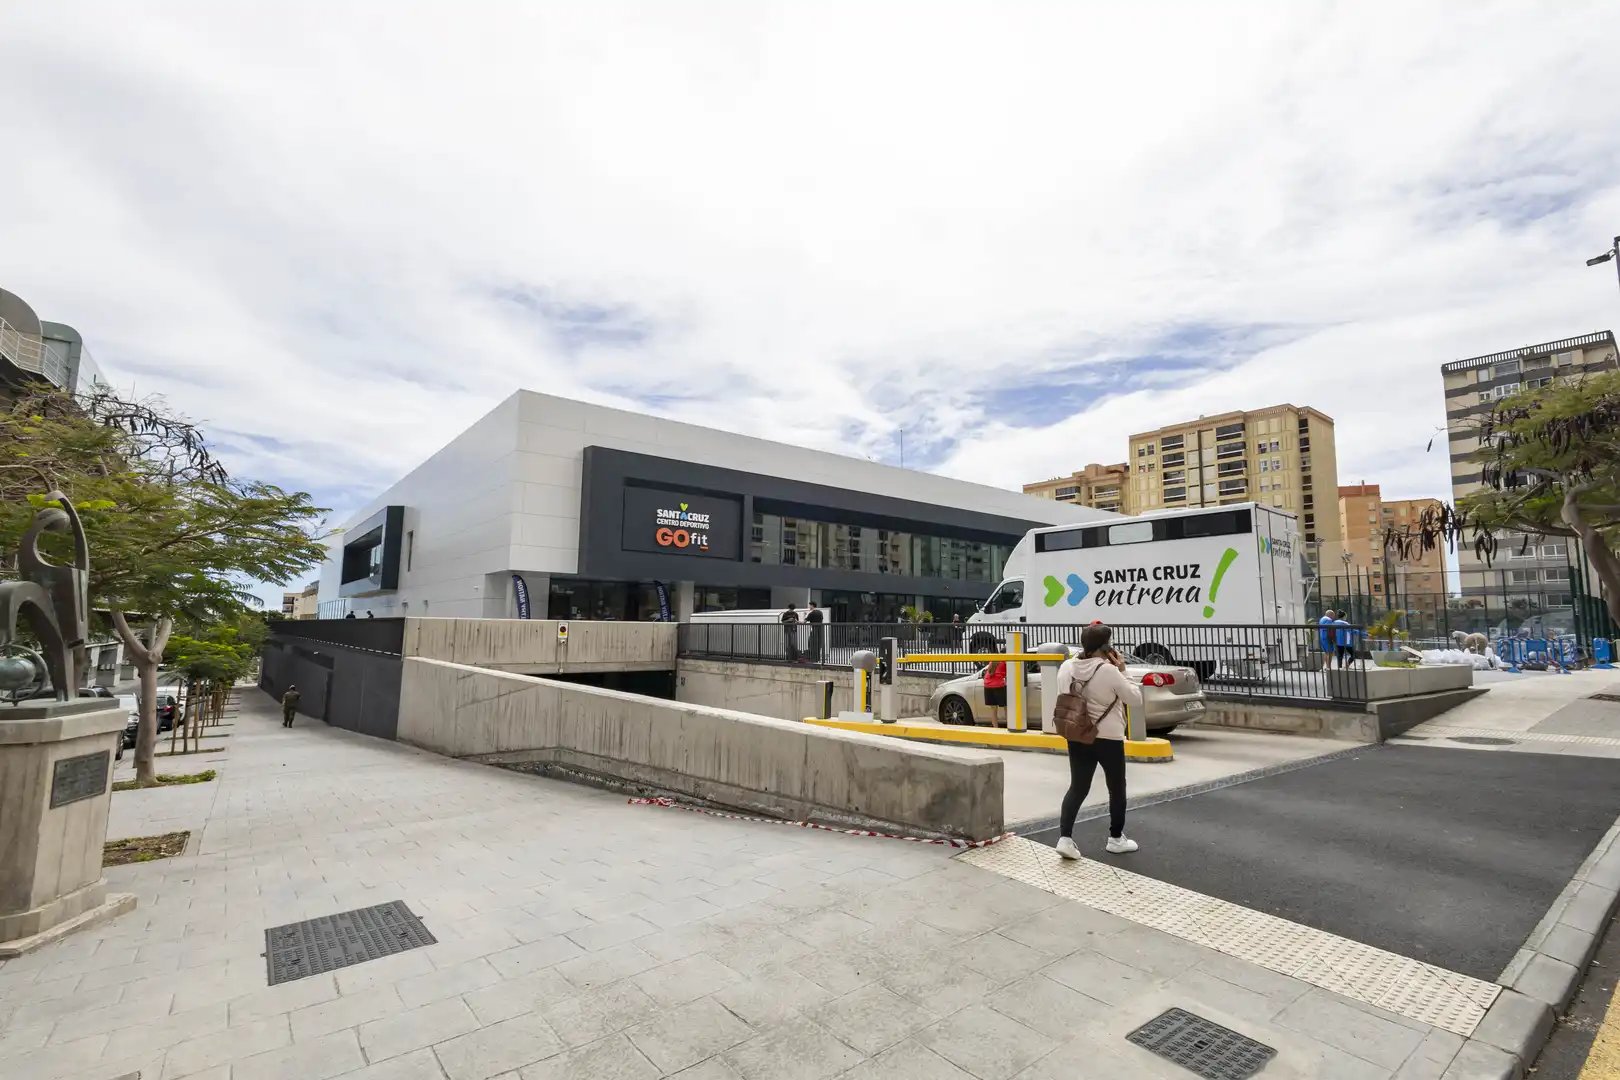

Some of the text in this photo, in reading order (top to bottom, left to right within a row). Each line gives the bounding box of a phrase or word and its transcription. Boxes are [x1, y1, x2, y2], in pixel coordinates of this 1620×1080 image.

[656, 518, 709, 529] CENTRO DEPORTIVO
[1094, 563, 1201, 584] SANTA CRUZ
